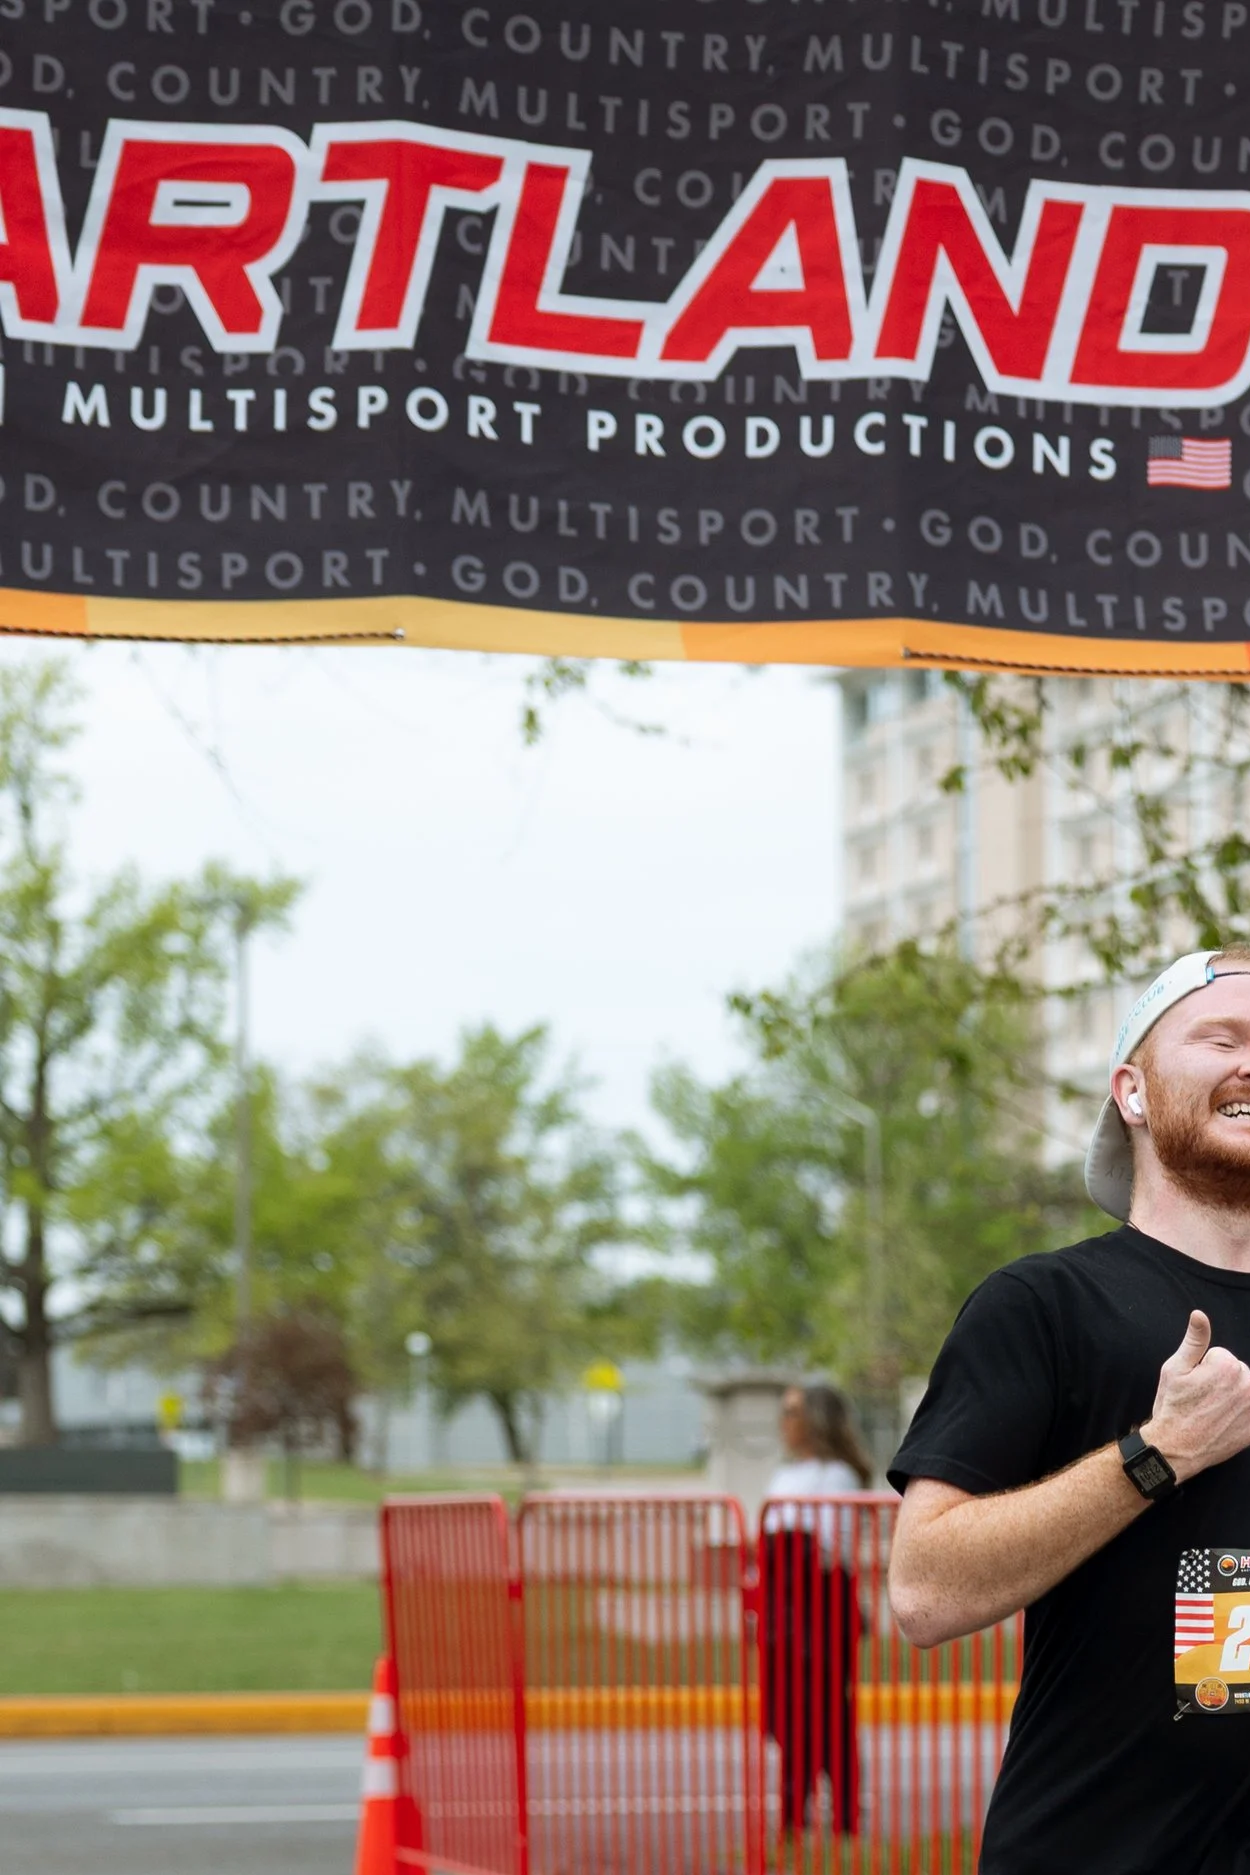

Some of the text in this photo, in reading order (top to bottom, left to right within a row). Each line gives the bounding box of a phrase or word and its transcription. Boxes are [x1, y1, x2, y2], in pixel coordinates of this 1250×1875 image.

[280, 0, 431, 40] GOD,
[461, 8, 775, 75] COUNTRY,
[803, 33, 1203, 106] MULTISPORT
[106, 62, 430, 108] COUNTRY,
[459, 77, 872, 141] MULTISPORT
[930, 108, 1068, 167] GOD,
[62, 380, 1117, 481] MULTISPORT PRODUCTIONS
[98, 479, 422, 522] COUNTRY,
[451, 487, 859, 546] MULTISPORT
[920, 508, 1057, 563] GOD,
[0, 541, 389, 590] ULTISPORT
[452, 555, 598, 608] GOD,
[628, 571, 940, 613] COUNTRY,
